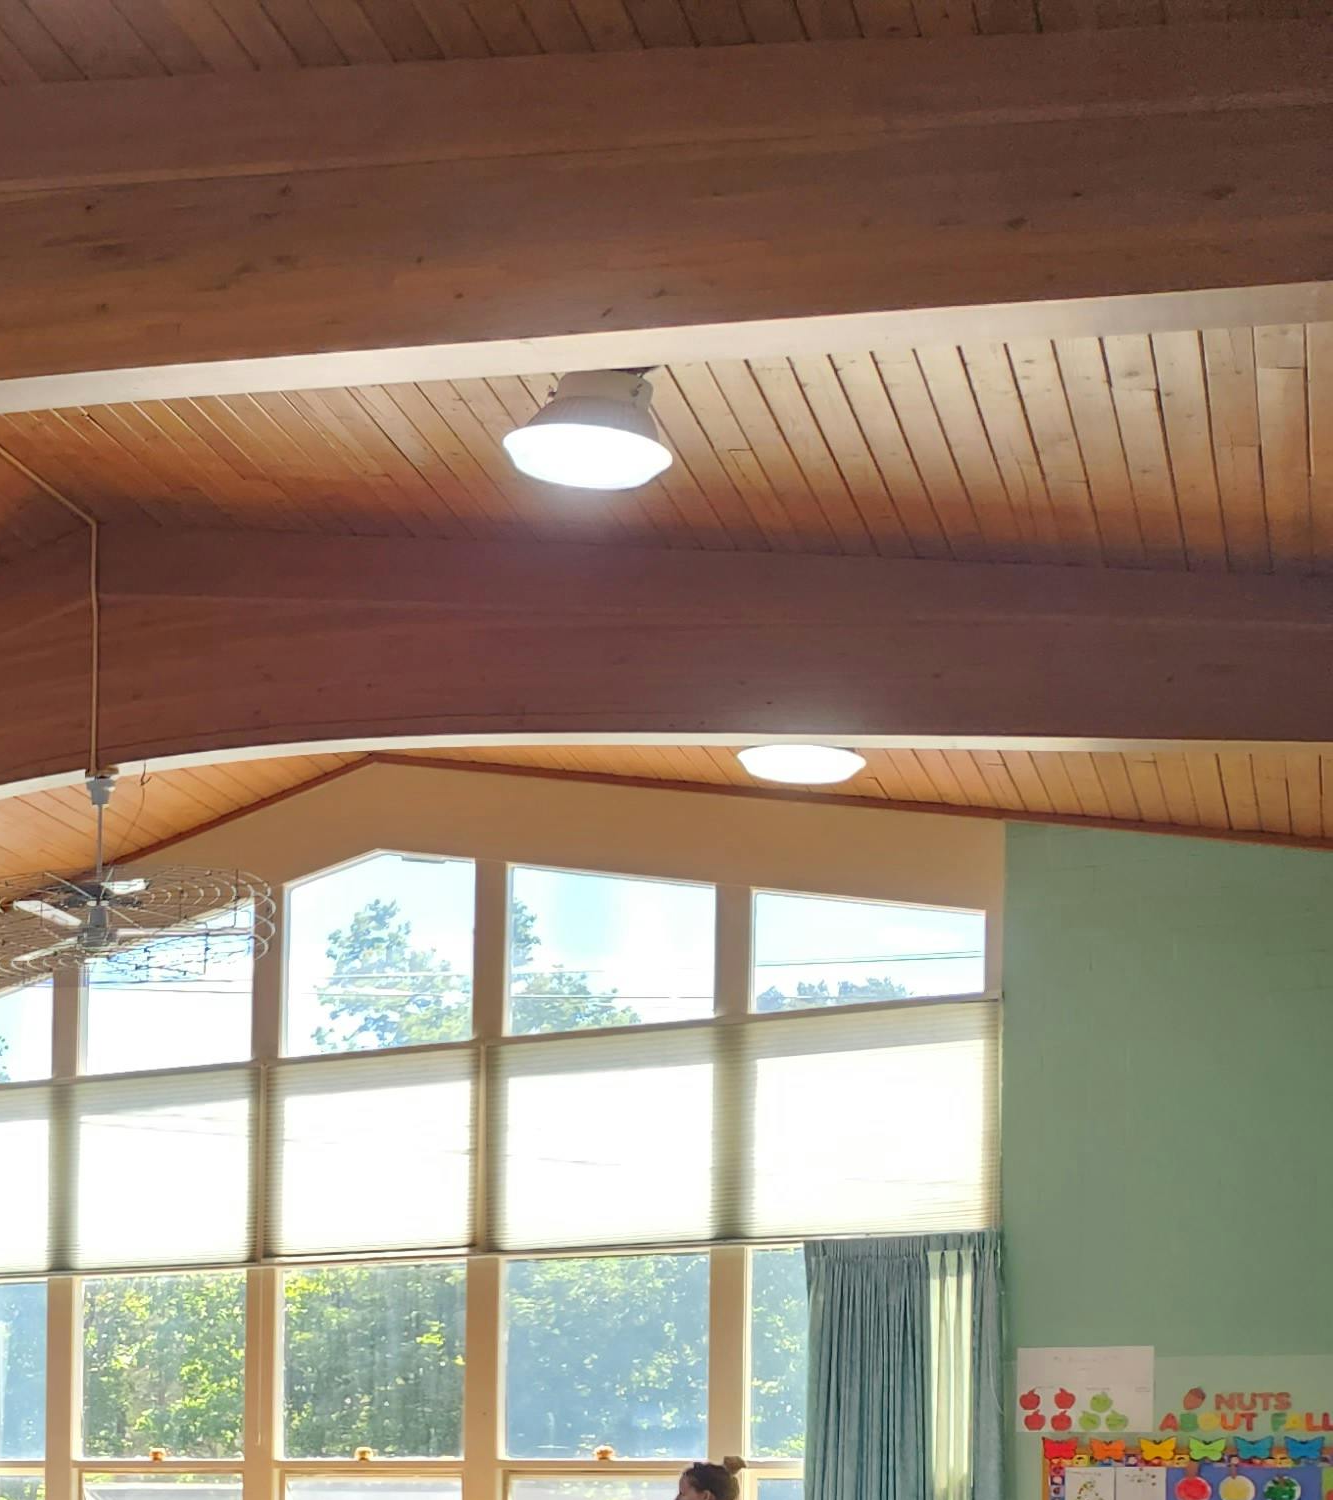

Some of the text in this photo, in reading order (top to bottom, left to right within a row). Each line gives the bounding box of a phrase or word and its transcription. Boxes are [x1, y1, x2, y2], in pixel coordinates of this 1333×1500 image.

[1214, 1391, 1292, 1411] NUTS
[1159, 1412, 1333, 1432] ABOUT FALL
